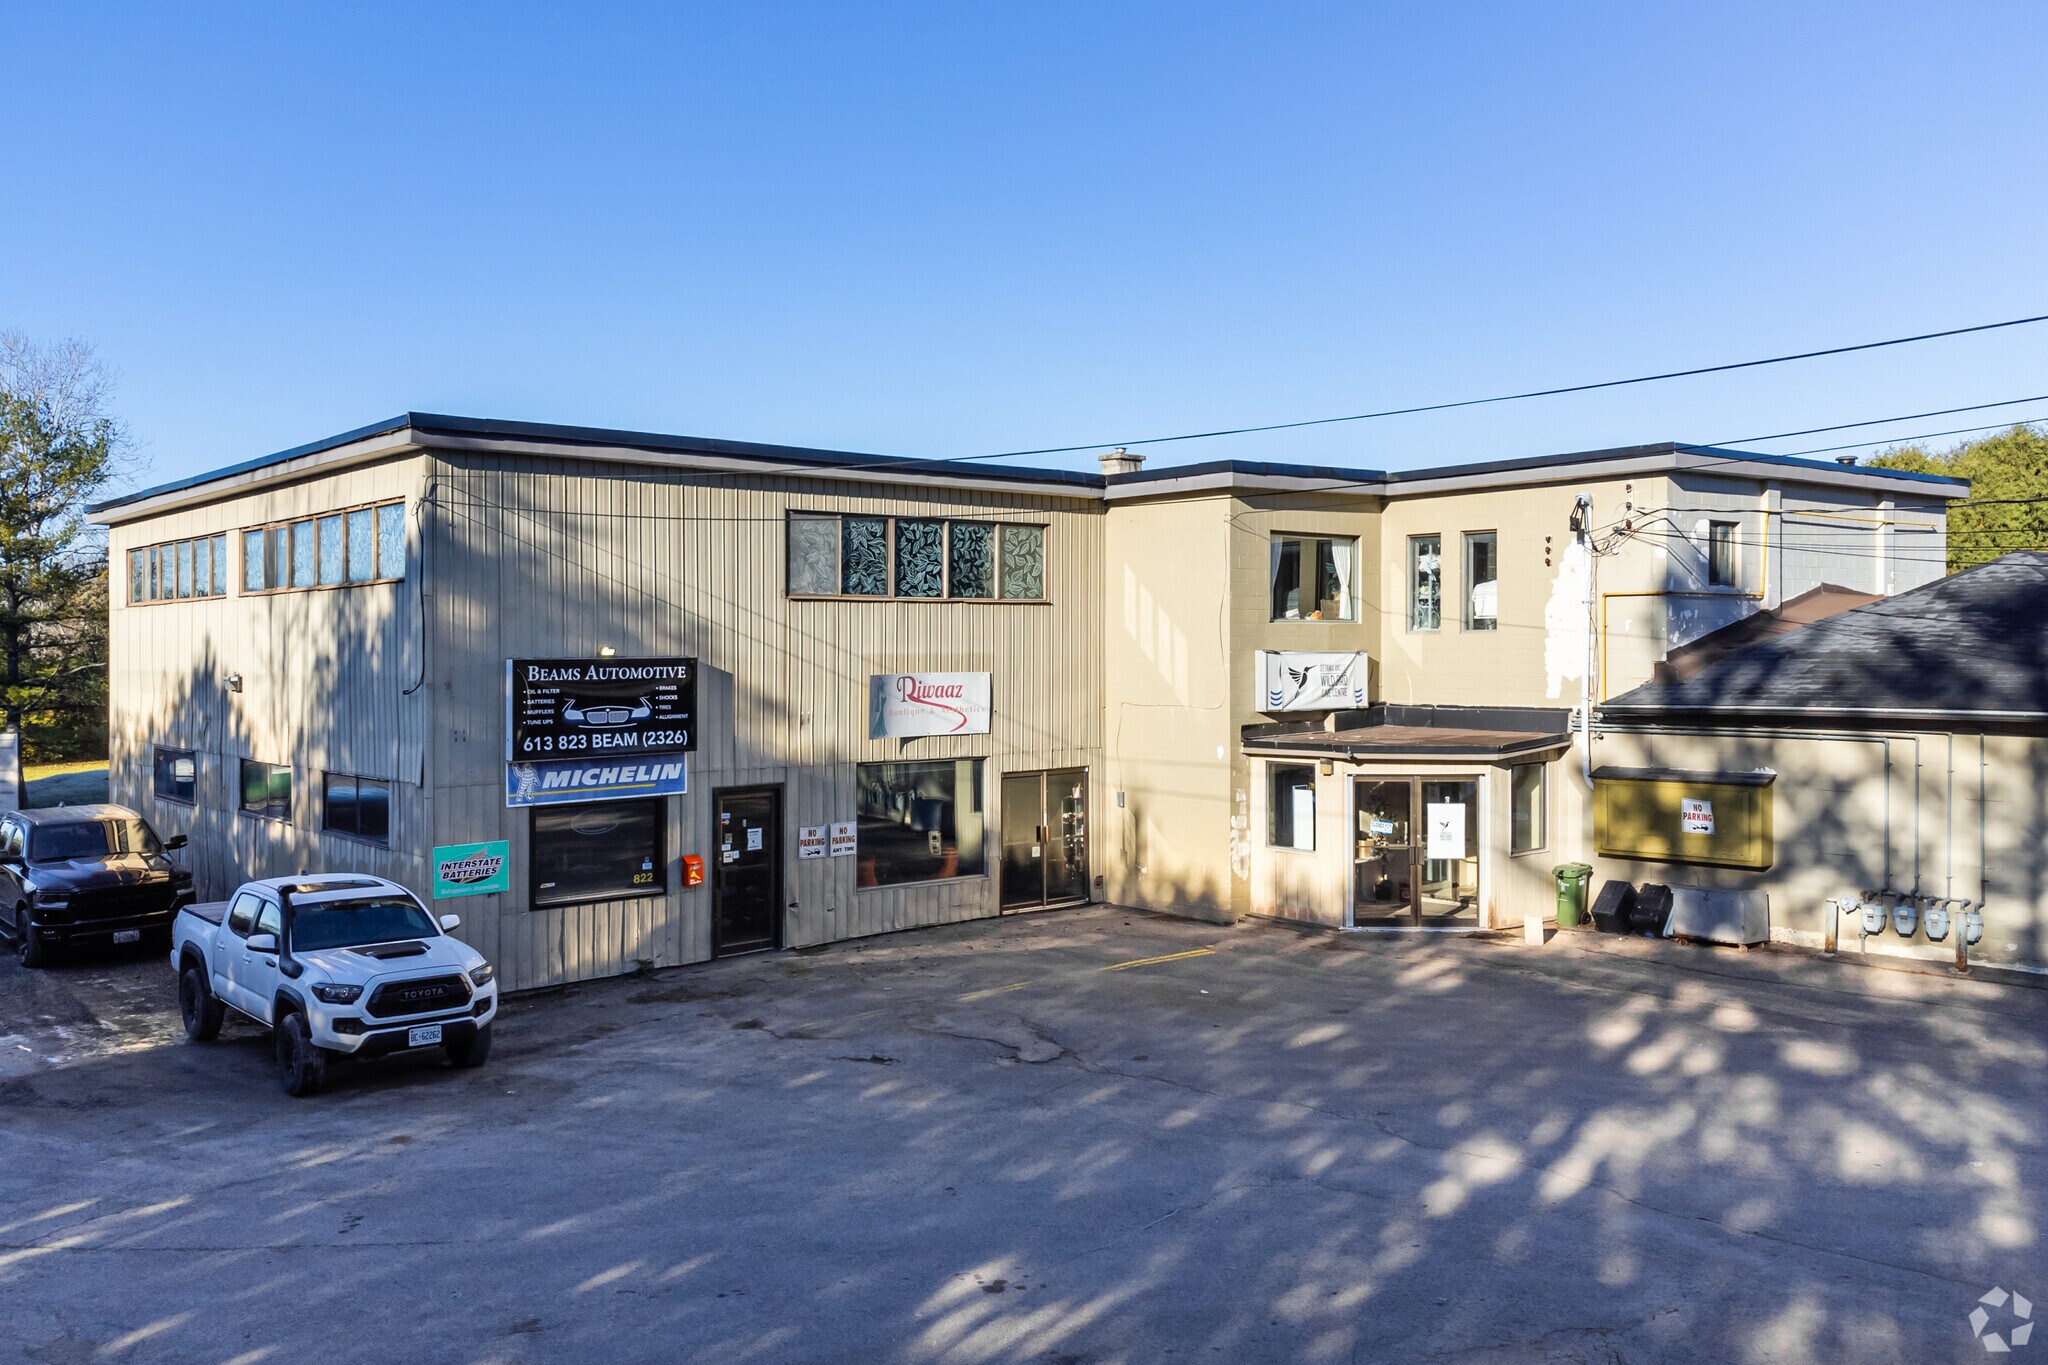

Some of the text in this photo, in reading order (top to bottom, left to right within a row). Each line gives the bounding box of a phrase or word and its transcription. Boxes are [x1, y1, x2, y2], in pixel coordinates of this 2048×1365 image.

[527, 664, 687, 681] BEAMS AUTOMOTIVE
[896, 675, 964, 706] Riwaaz
[523, 730, 688, 752] 613 823 BEAM (2326)
[542, 763, 683, 788] MICHELIN
[1693, 804, 1703, 812] NO
[1683, 812, 1713, 823] PARKING
[807, 829, 818, 838] NO
[838, 826, 848, 835] NO
[799, 838, 826, 848] PARKING
[831, 834, 856, 846] PARKING
[440, 857, 503, 871] INTERSTATE
[442, 867, 498, 880] BATTERIES
[633, 872, 654, 884] 822
[404, 987, 444, 999] TOYOTA
